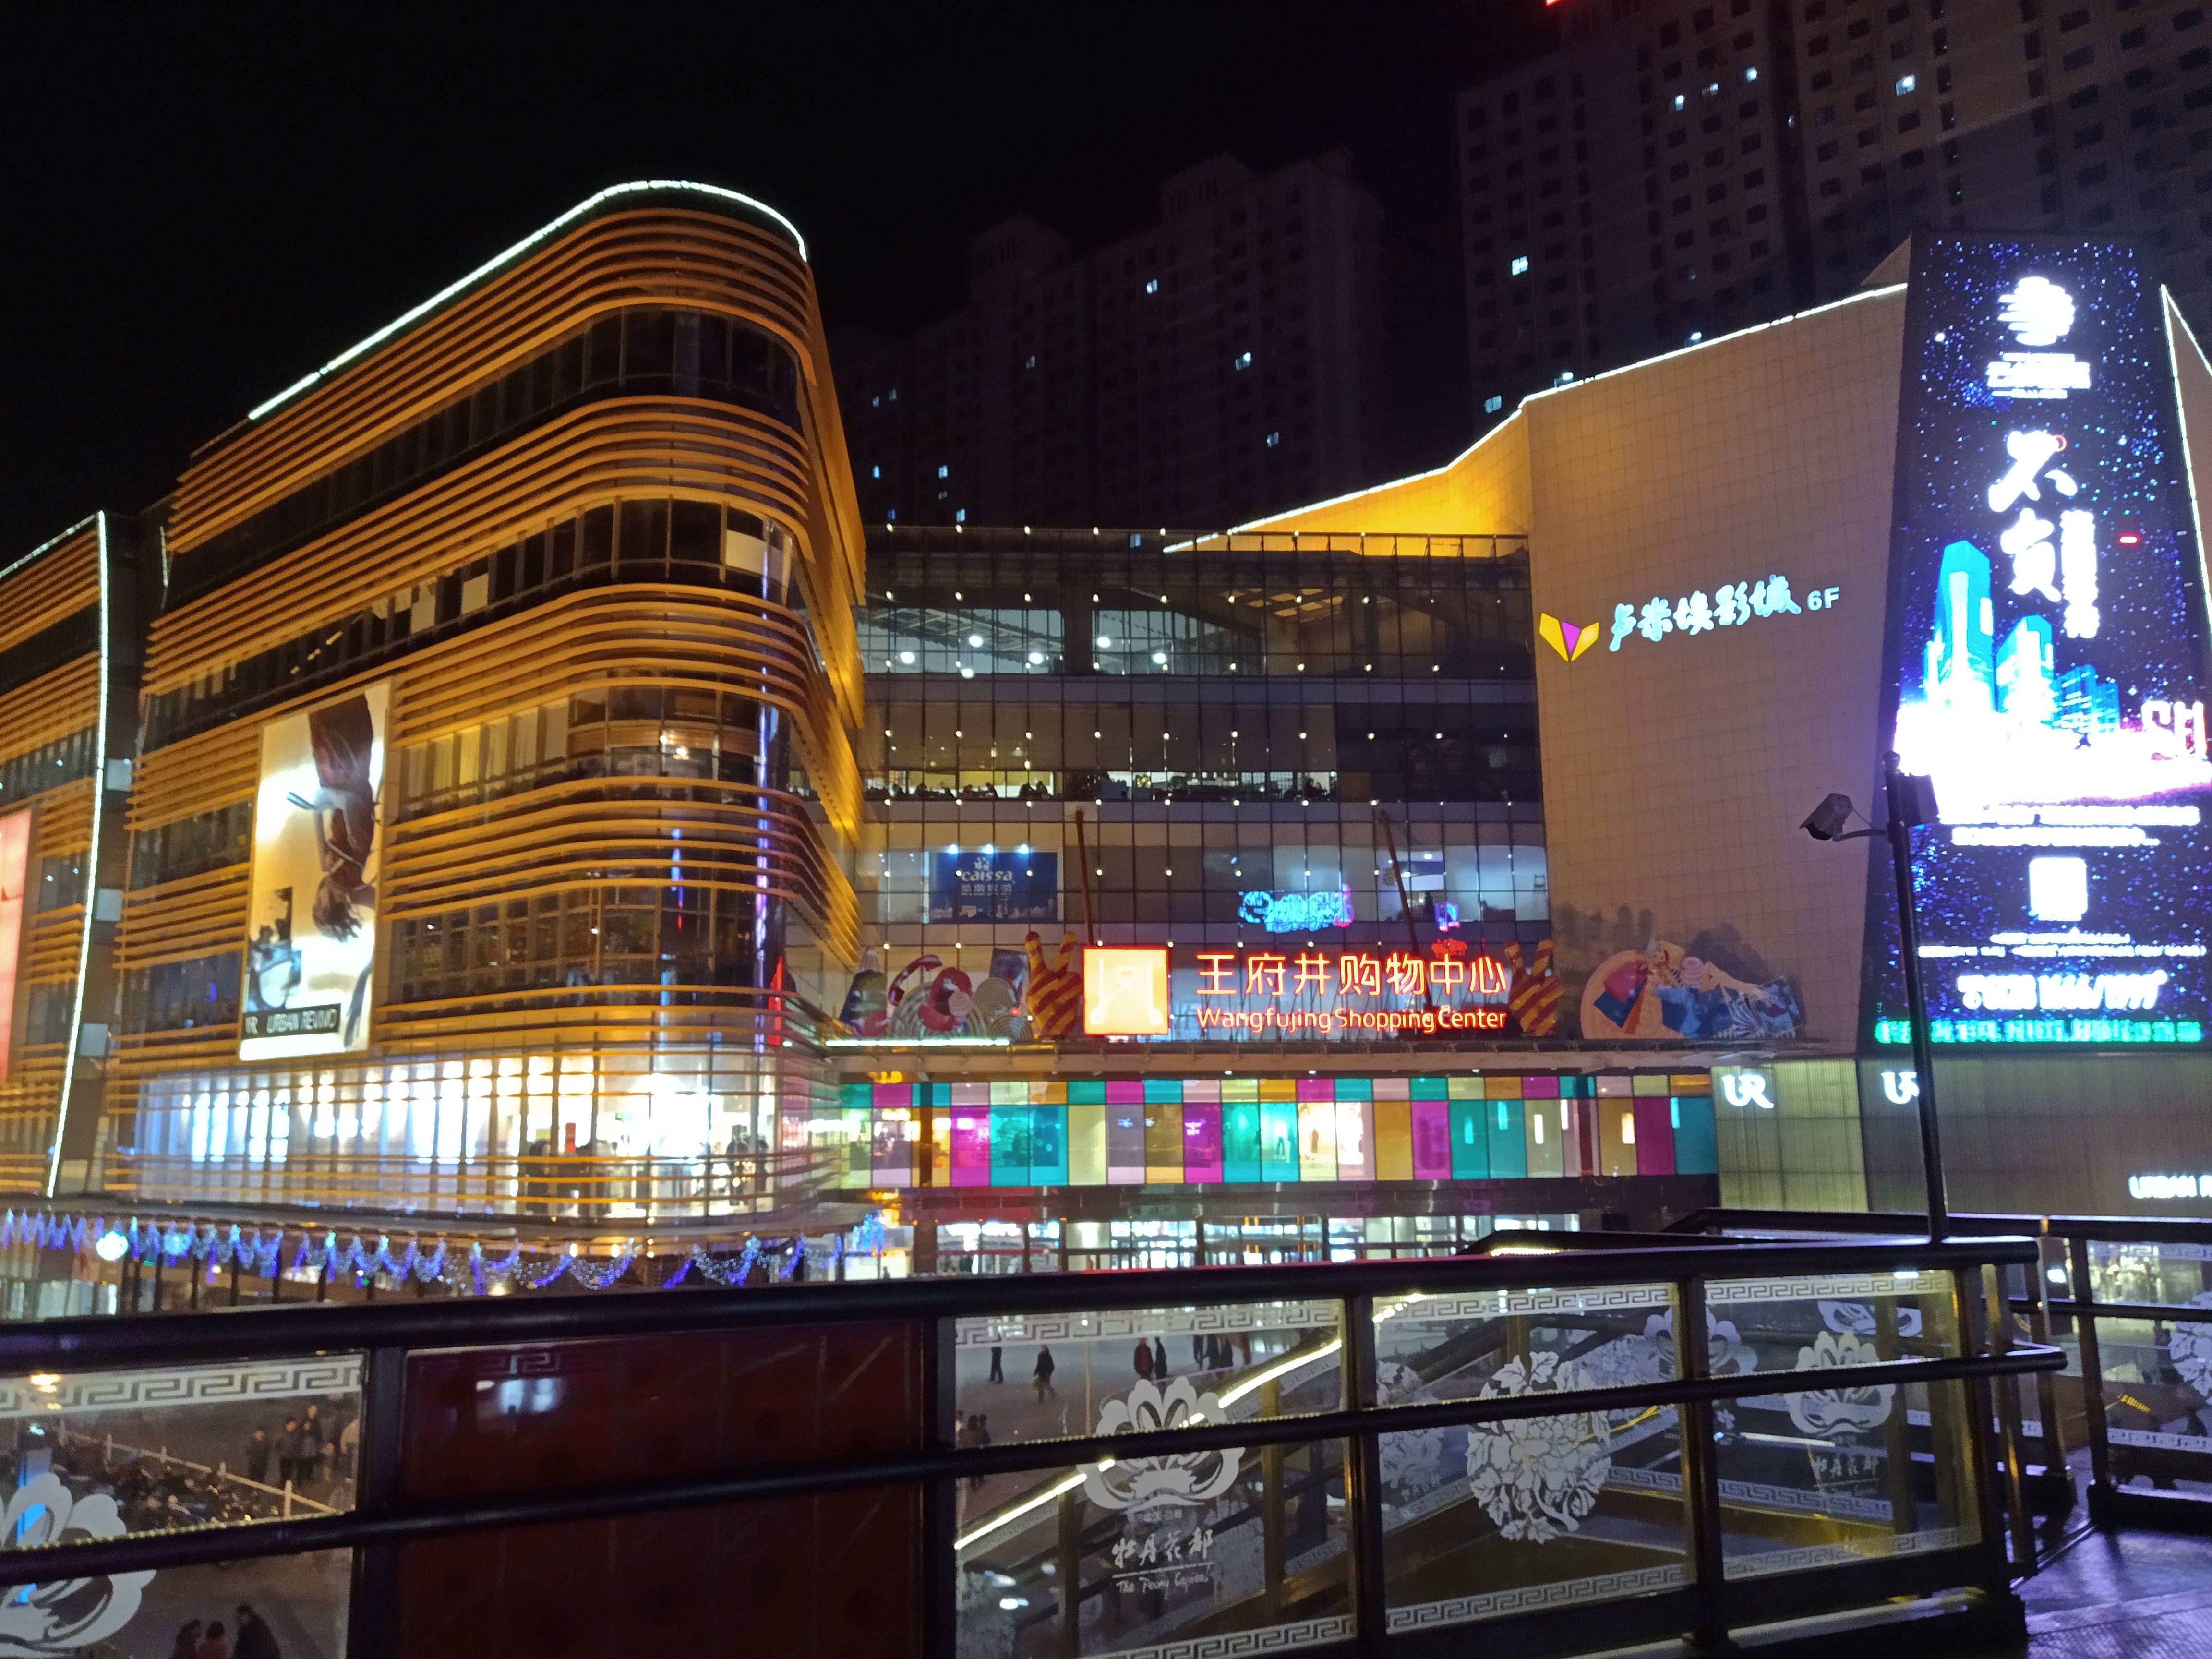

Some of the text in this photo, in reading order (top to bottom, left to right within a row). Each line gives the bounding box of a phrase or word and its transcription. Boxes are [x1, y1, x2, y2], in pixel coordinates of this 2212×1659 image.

[1806, 586, 1840, 611] 6F
[961, 870, 1013, 882] caissa
[1195, 952, 1508, 997] 王府井购物中心
[1196, 1007, 1506, 1034] Wangfujing Shopping Center
[1721, 1075, 1774, 1109] UR
[1111, 1526, 1214, 1569] 牡丹花都
